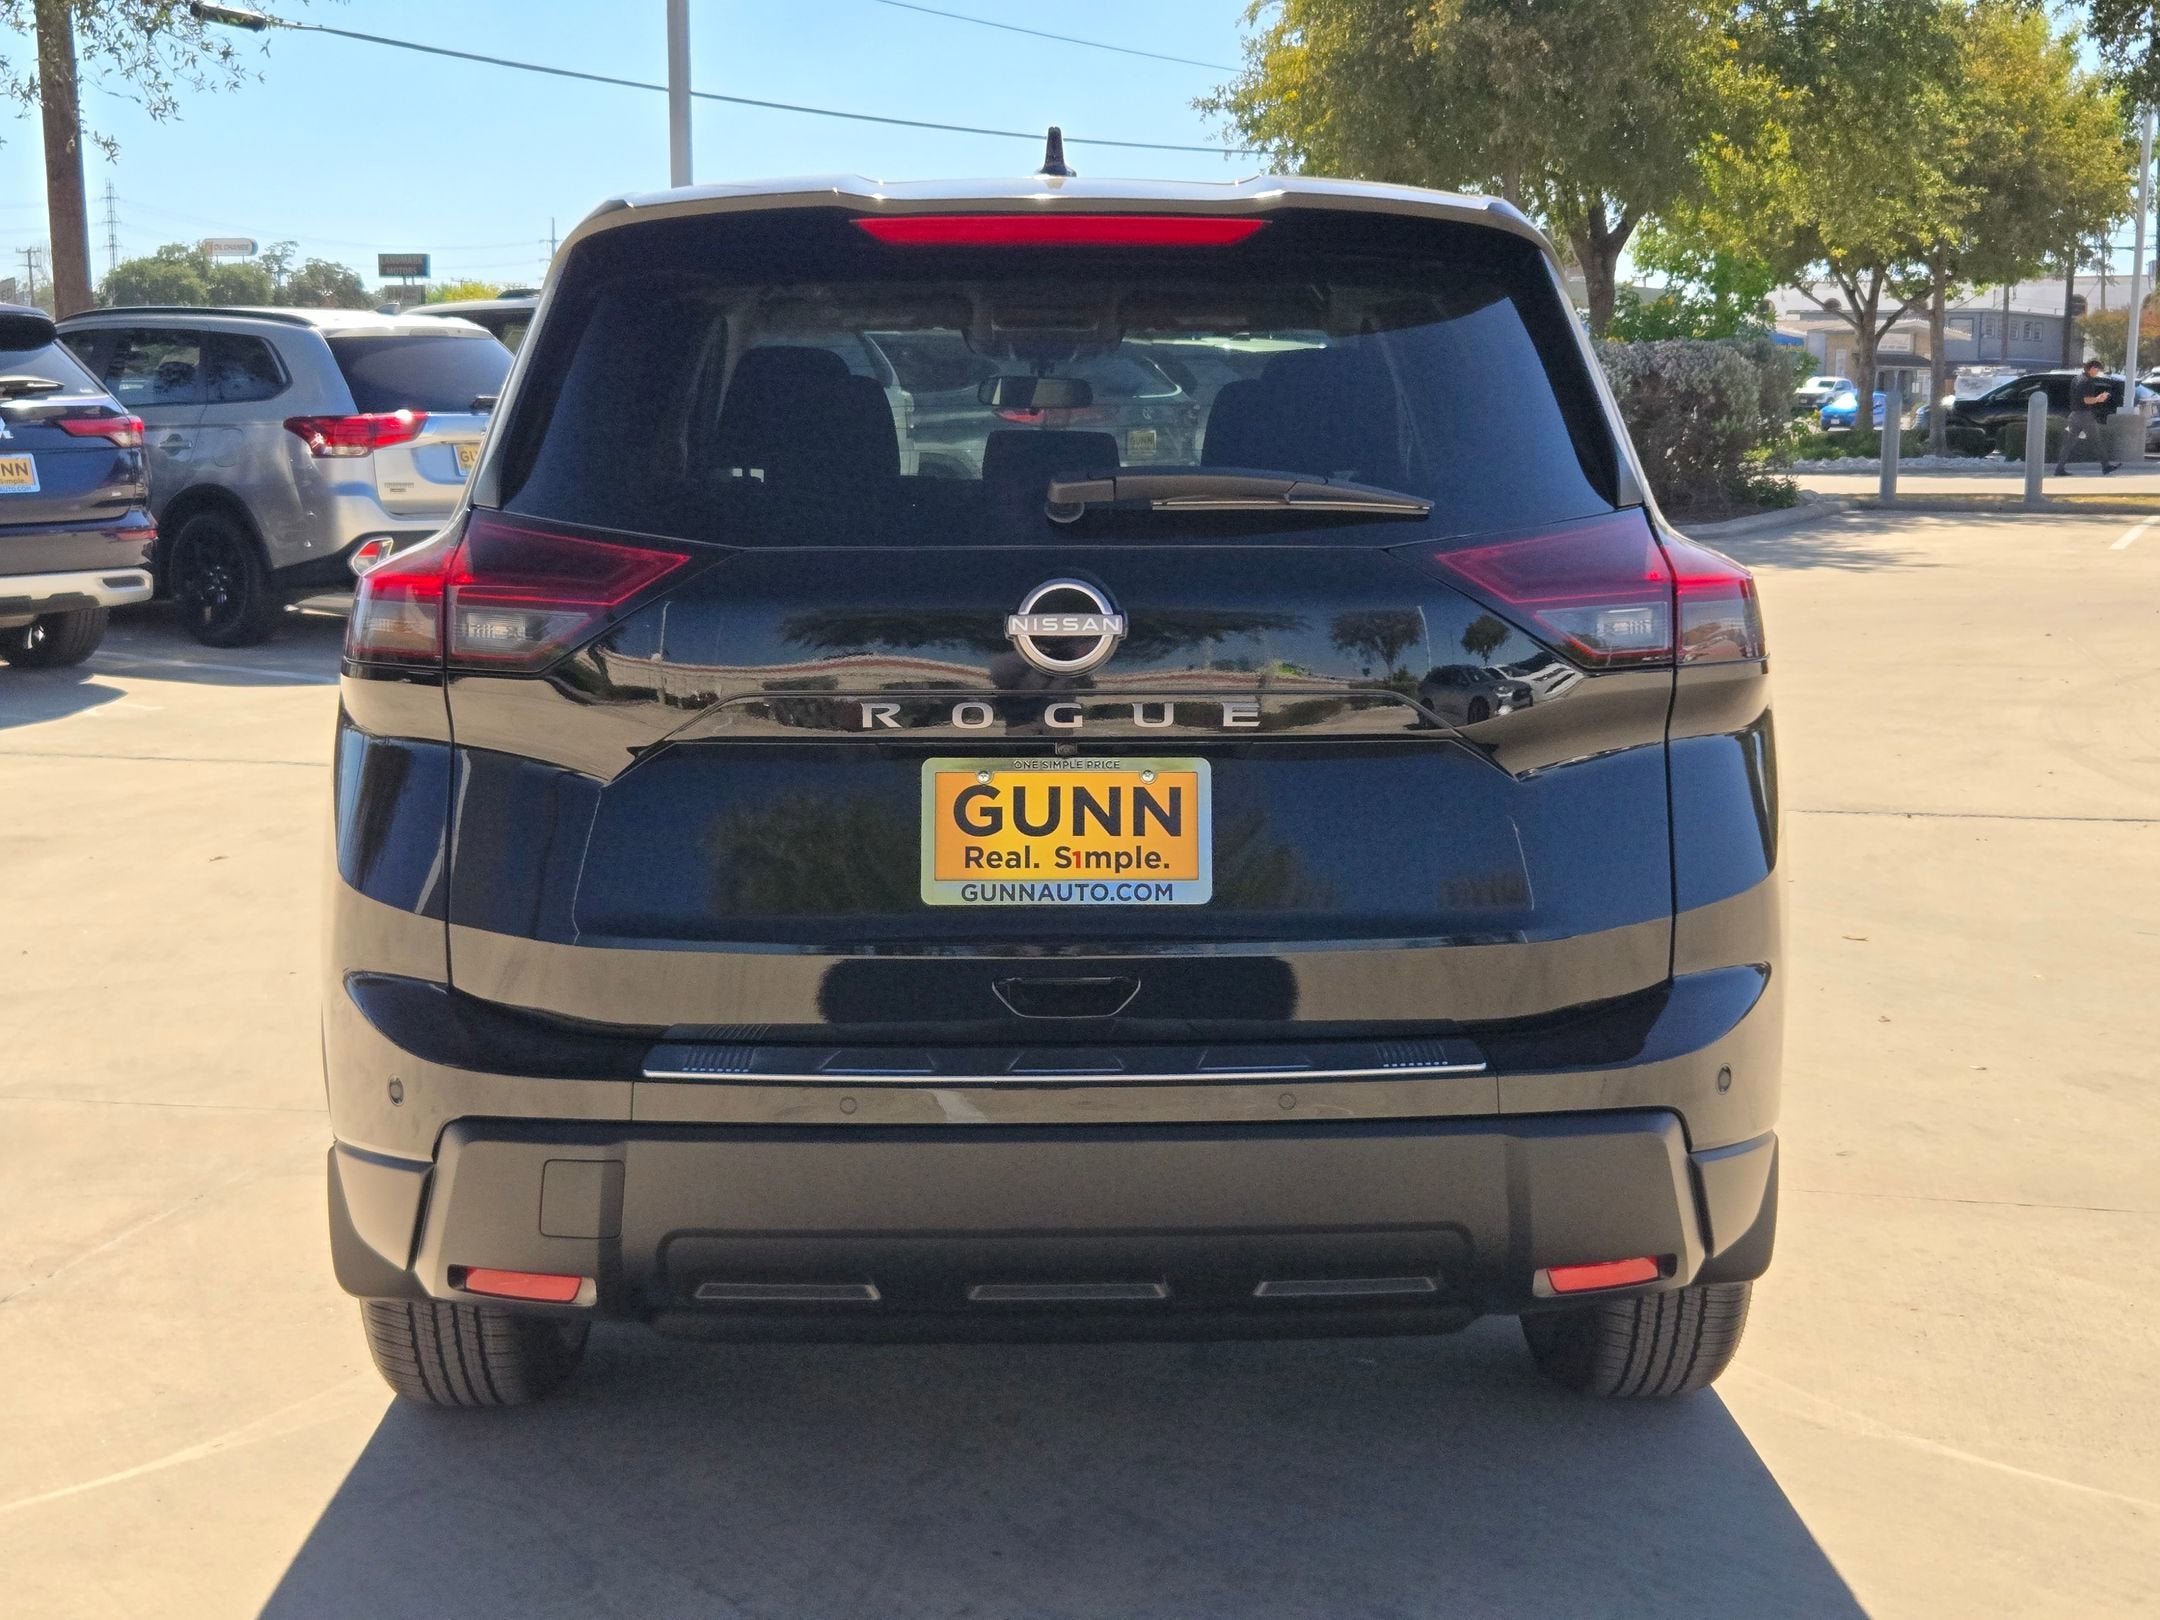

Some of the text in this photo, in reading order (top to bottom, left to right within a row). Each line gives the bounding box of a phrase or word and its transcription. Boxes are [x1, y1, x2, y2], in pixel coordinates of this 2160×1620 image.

[385, 266, 417, 275] MOTORS
[1012, 617, 1120, 631] NISSAN
[861, 702, 1261, 728] ROGUE
[1014, 760, 1120, 769] ONE SIMPLE PRICE
[953, 784, 1182, 837] GUNN
[964, 845, 1040, 869] Real.
[961, 883, 1173, 901] GUNNAUTO.COM
